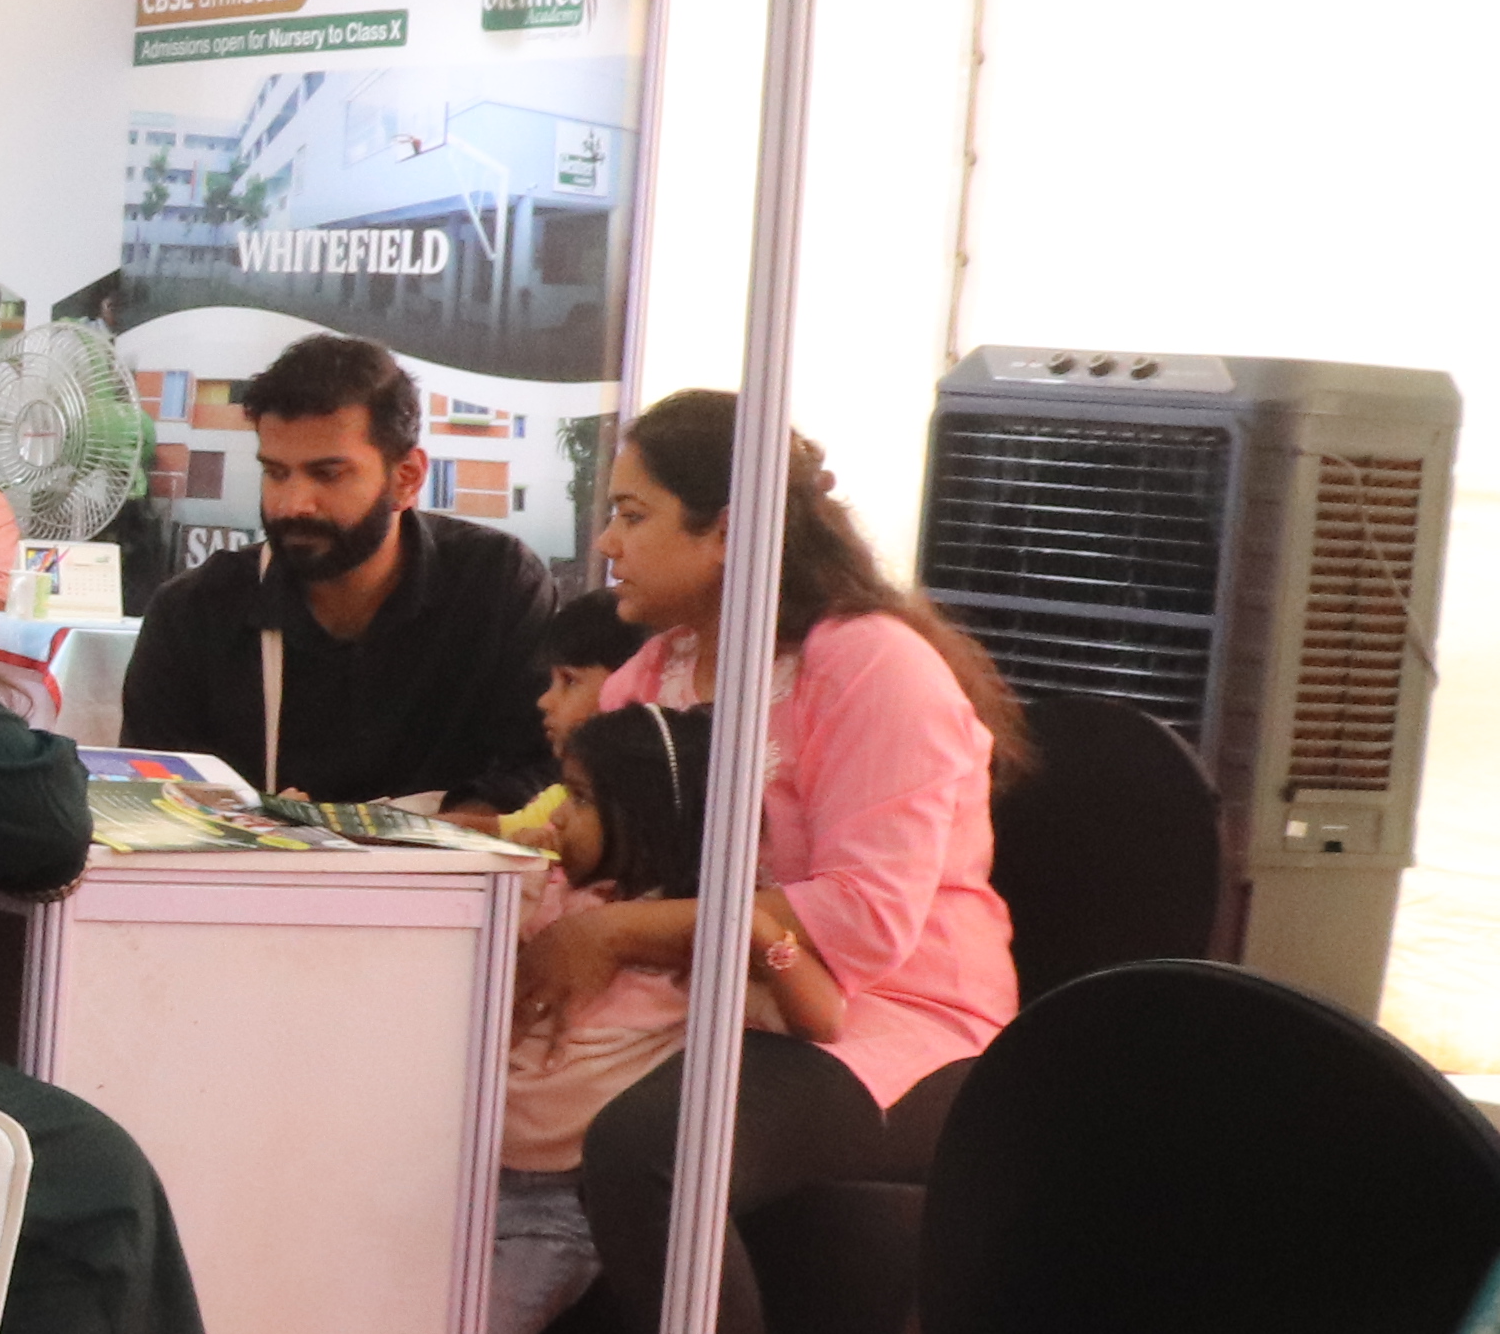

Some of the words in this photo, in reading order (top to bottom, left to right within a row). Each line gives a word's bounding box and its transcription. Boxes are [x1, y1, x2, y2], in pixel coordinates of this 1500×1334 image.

[141, 35, 212, 60] Admissions
[213, 34, 245, 57] open
[249, 29, 268, 51] for
[268, 27, 326, 51] Nursery
[327, 25, 344, 45] to
[345, 20, 388, 43] Class
[388, 19, 402, 41] X
[237, 227, 451, 275] WHITEFIELD
